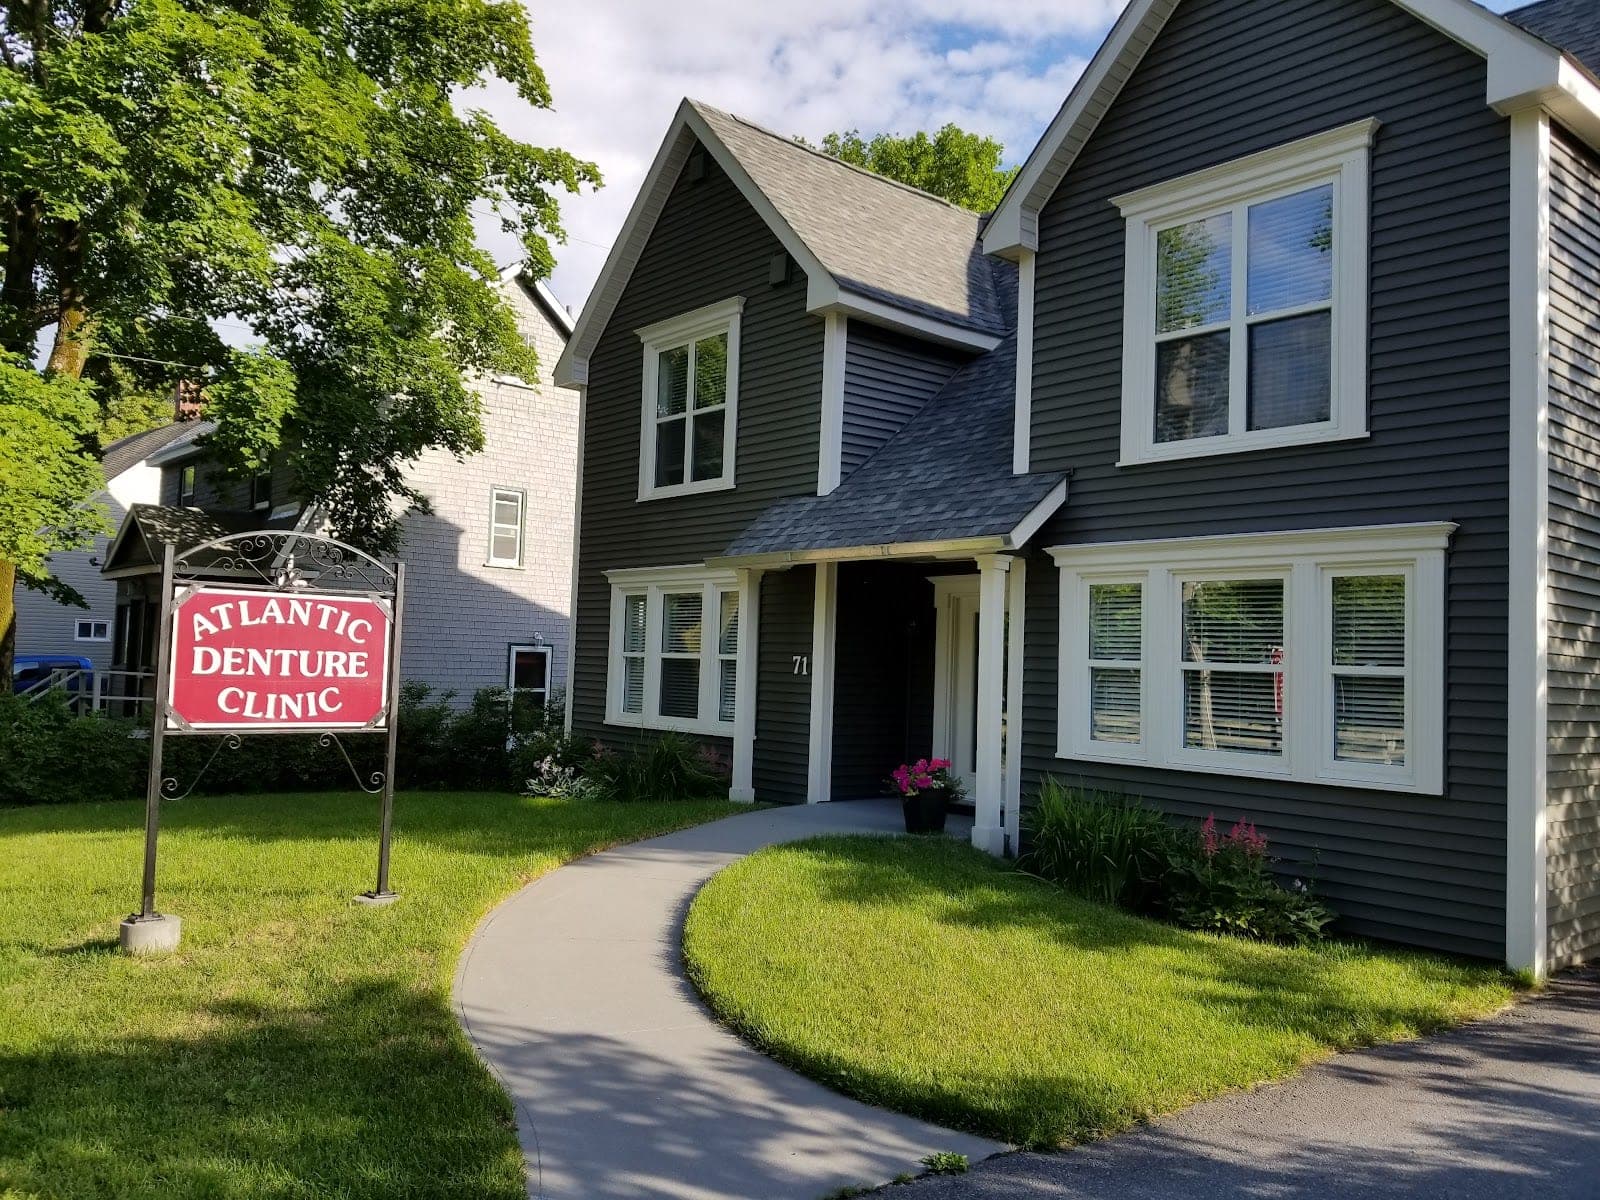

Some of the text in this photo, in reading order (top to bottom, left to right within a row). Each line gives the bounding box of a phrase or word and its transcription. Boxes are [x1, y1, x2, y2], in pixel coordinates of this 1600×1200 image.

[192, 599, 372, 644] ATLANTIC
[192, 646, 369, 678] DENTURE
[792, 655, 808, 675] 71
[217, 687, 343, 719] CLINIC
